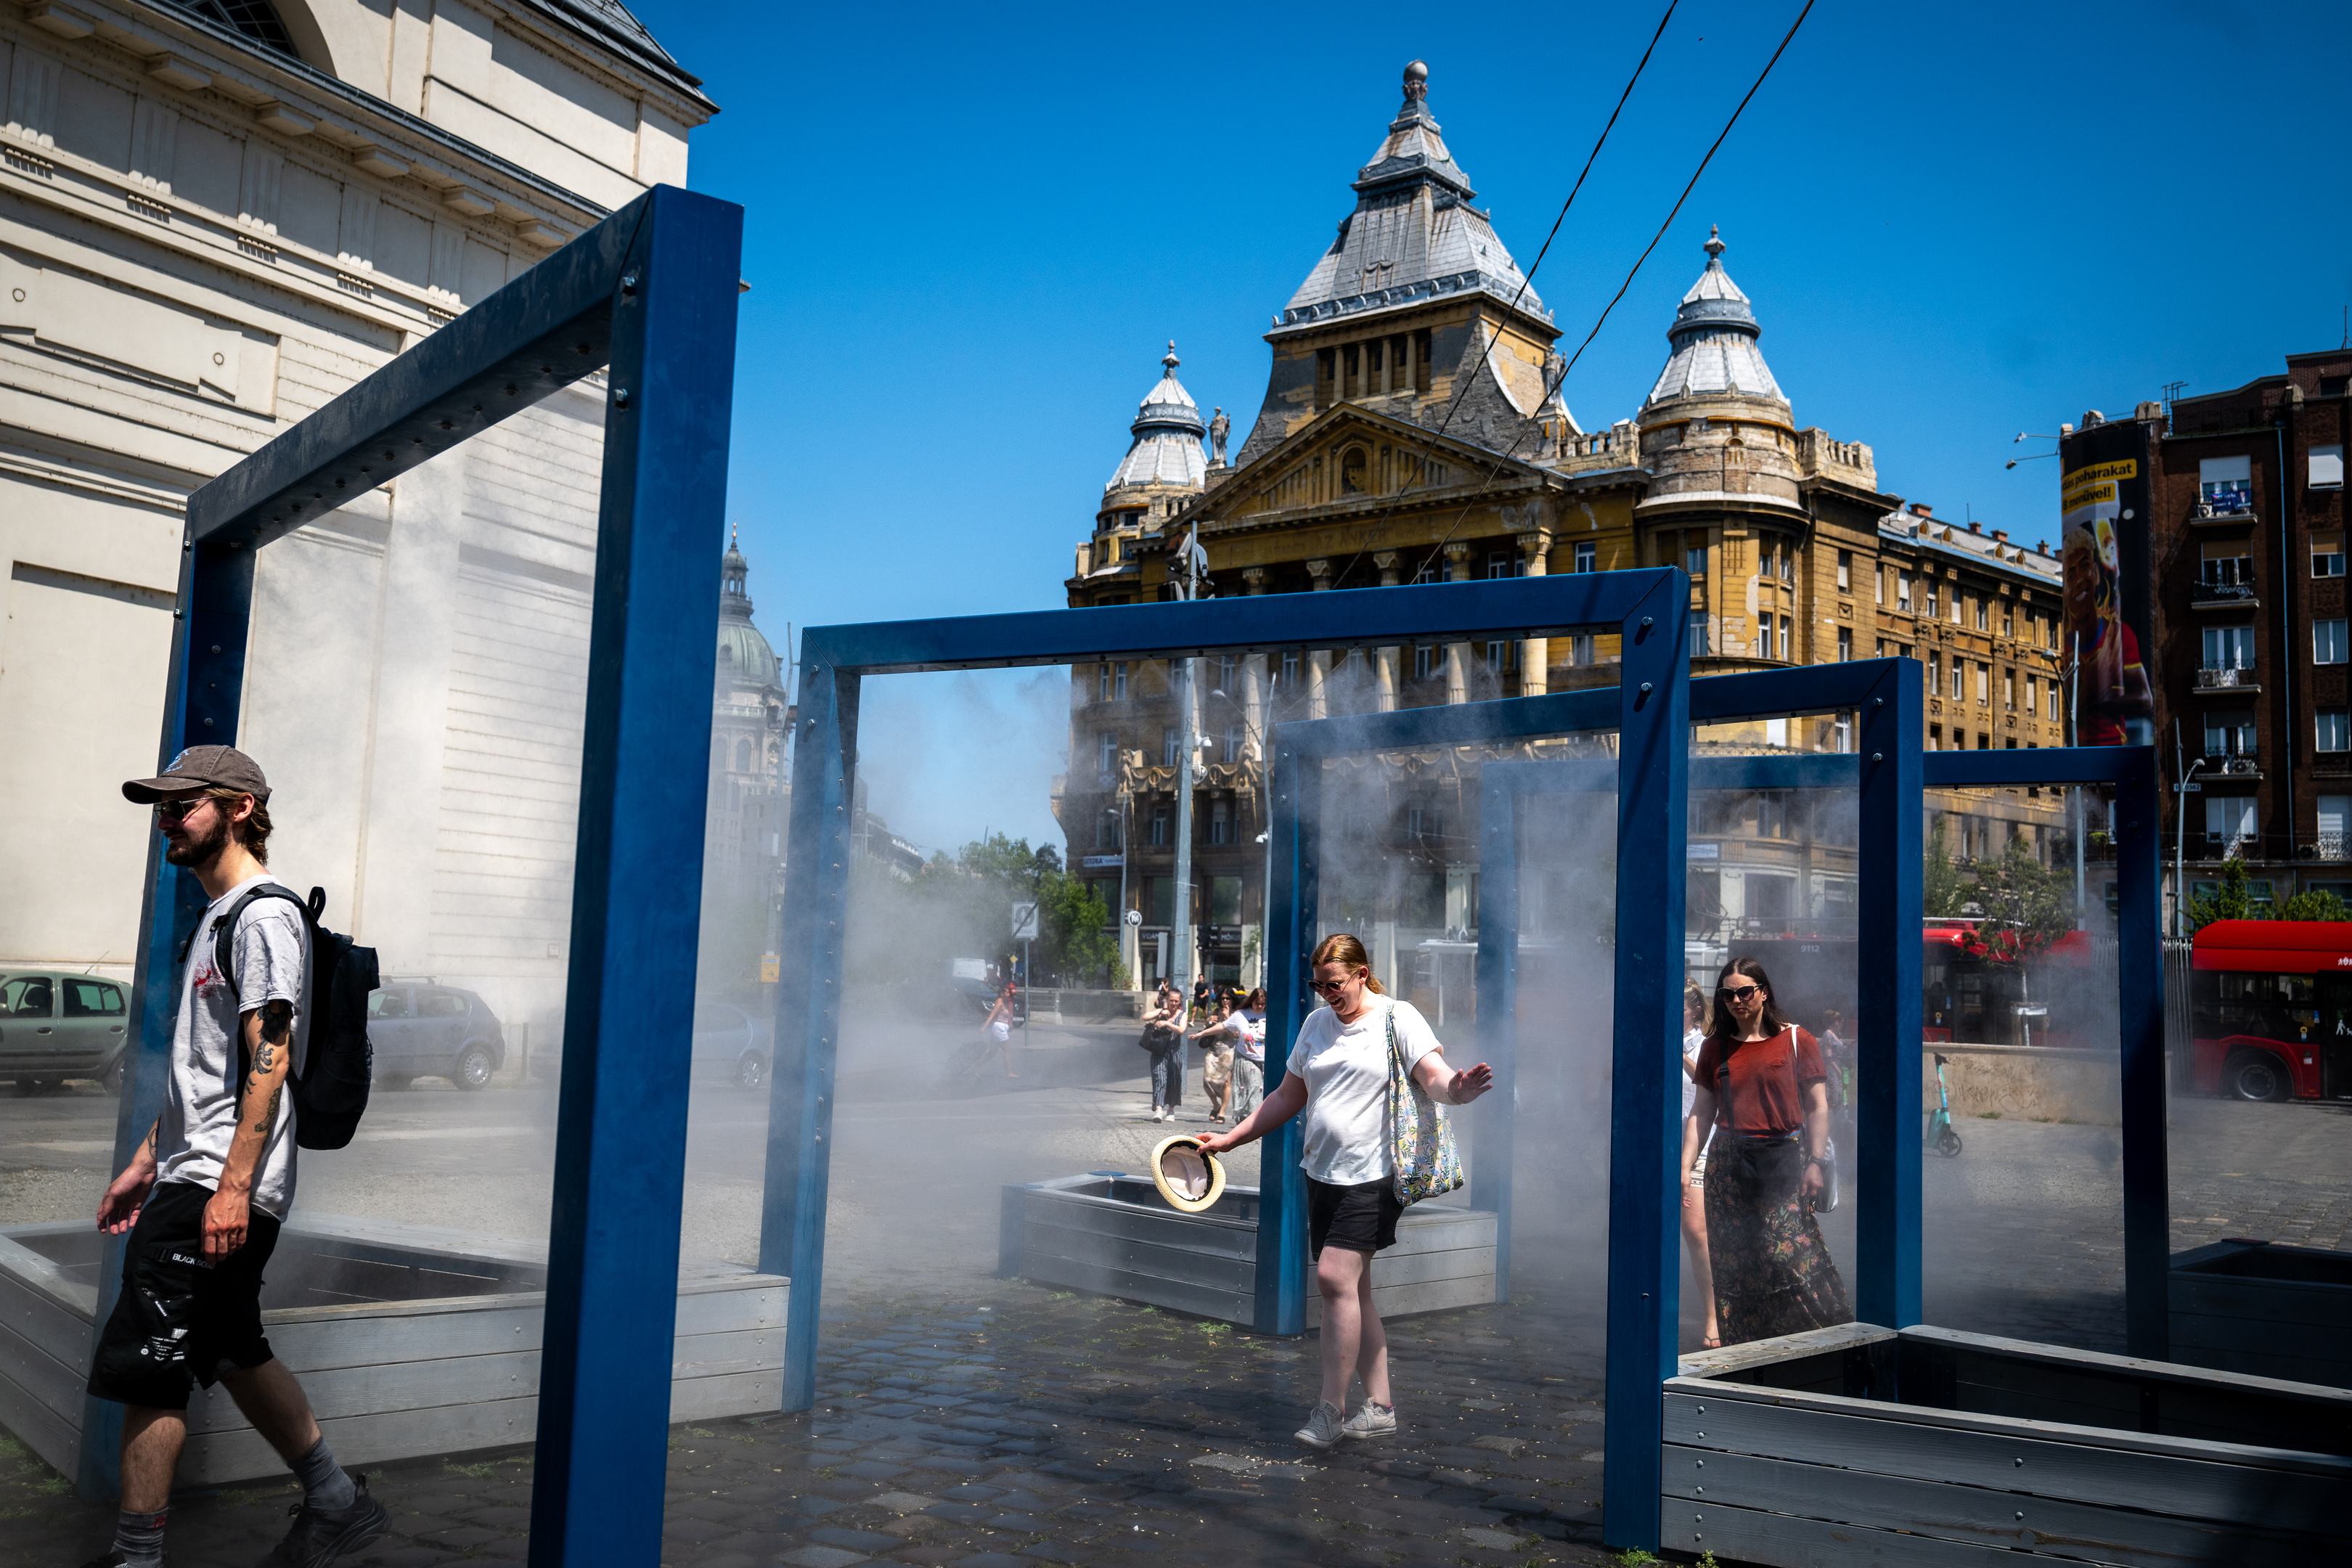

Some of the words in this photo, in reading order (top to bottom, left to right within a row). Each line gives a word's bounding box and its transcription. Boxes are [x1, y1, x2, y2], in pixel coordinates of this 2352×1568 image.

[2075, 463, 2132, 486] poharakat
[2069, 486, 2111, 507] menüvel!
[172, 1253, 197, 1265] BLACK
